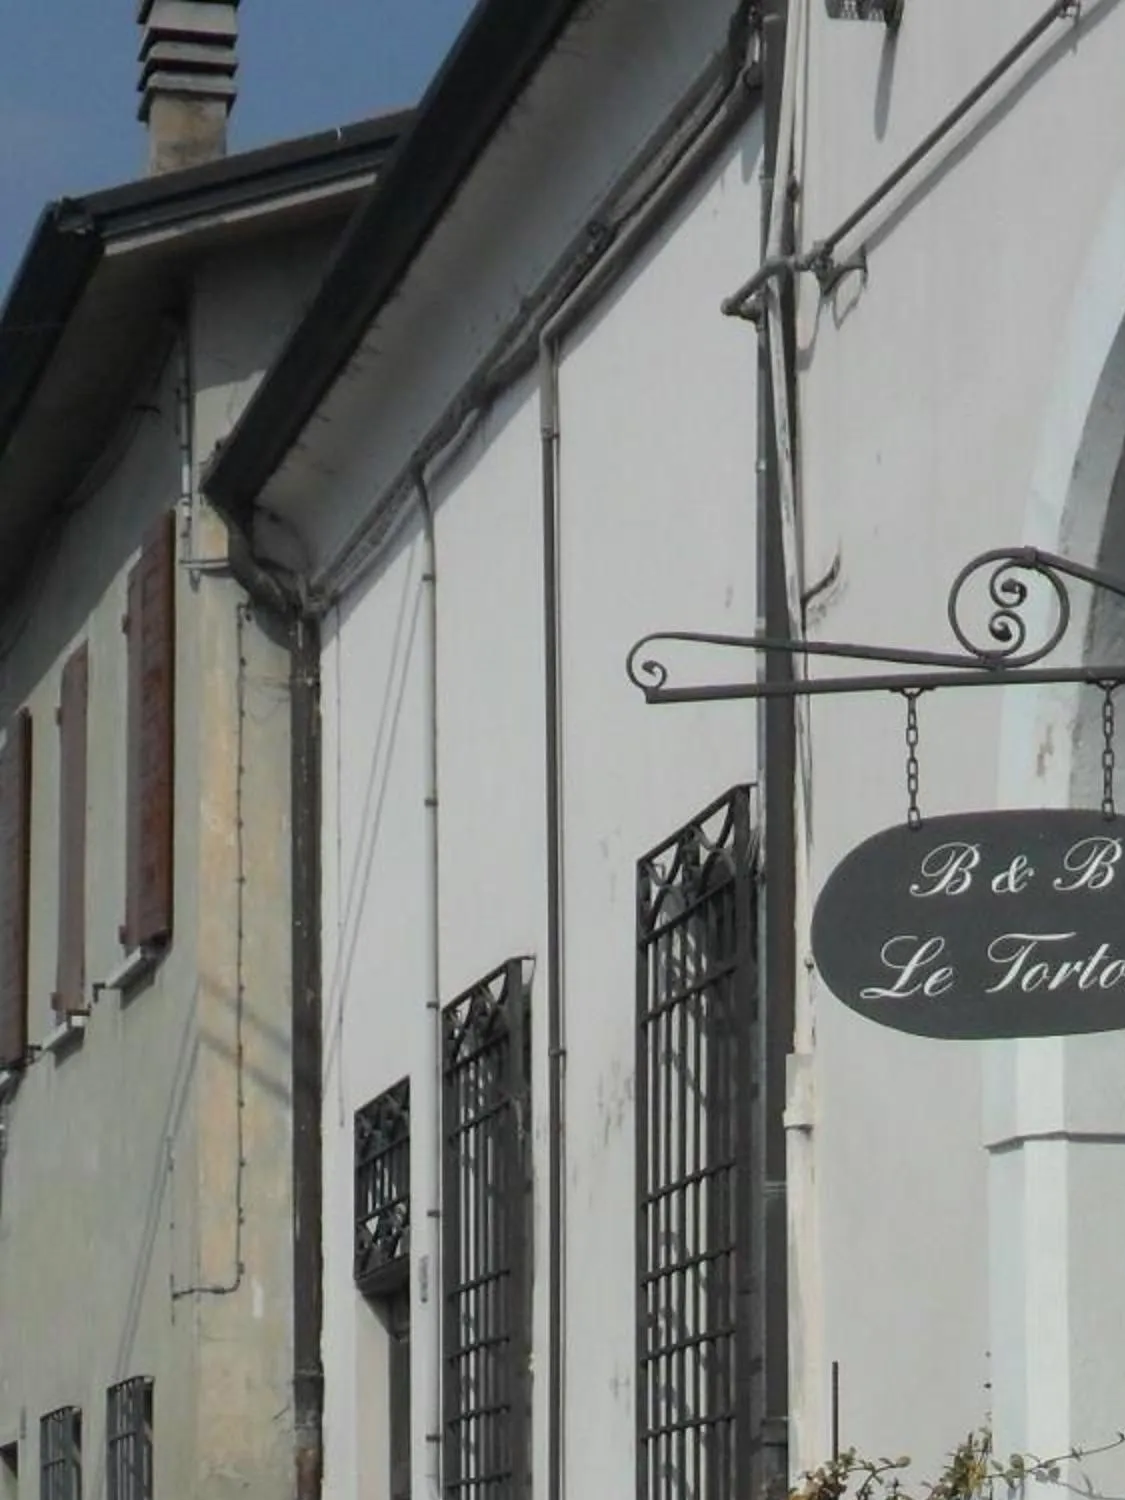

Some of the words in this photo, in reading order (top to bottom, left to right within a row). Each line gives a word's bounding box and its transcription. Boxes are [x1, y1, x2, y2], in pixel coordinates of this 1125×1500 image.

[909, 841, 981, 897] B
[991, 854, 1035, 893] &
[1052, 836, 1123, 891] B
[859, 935, 954, 1000] Le
